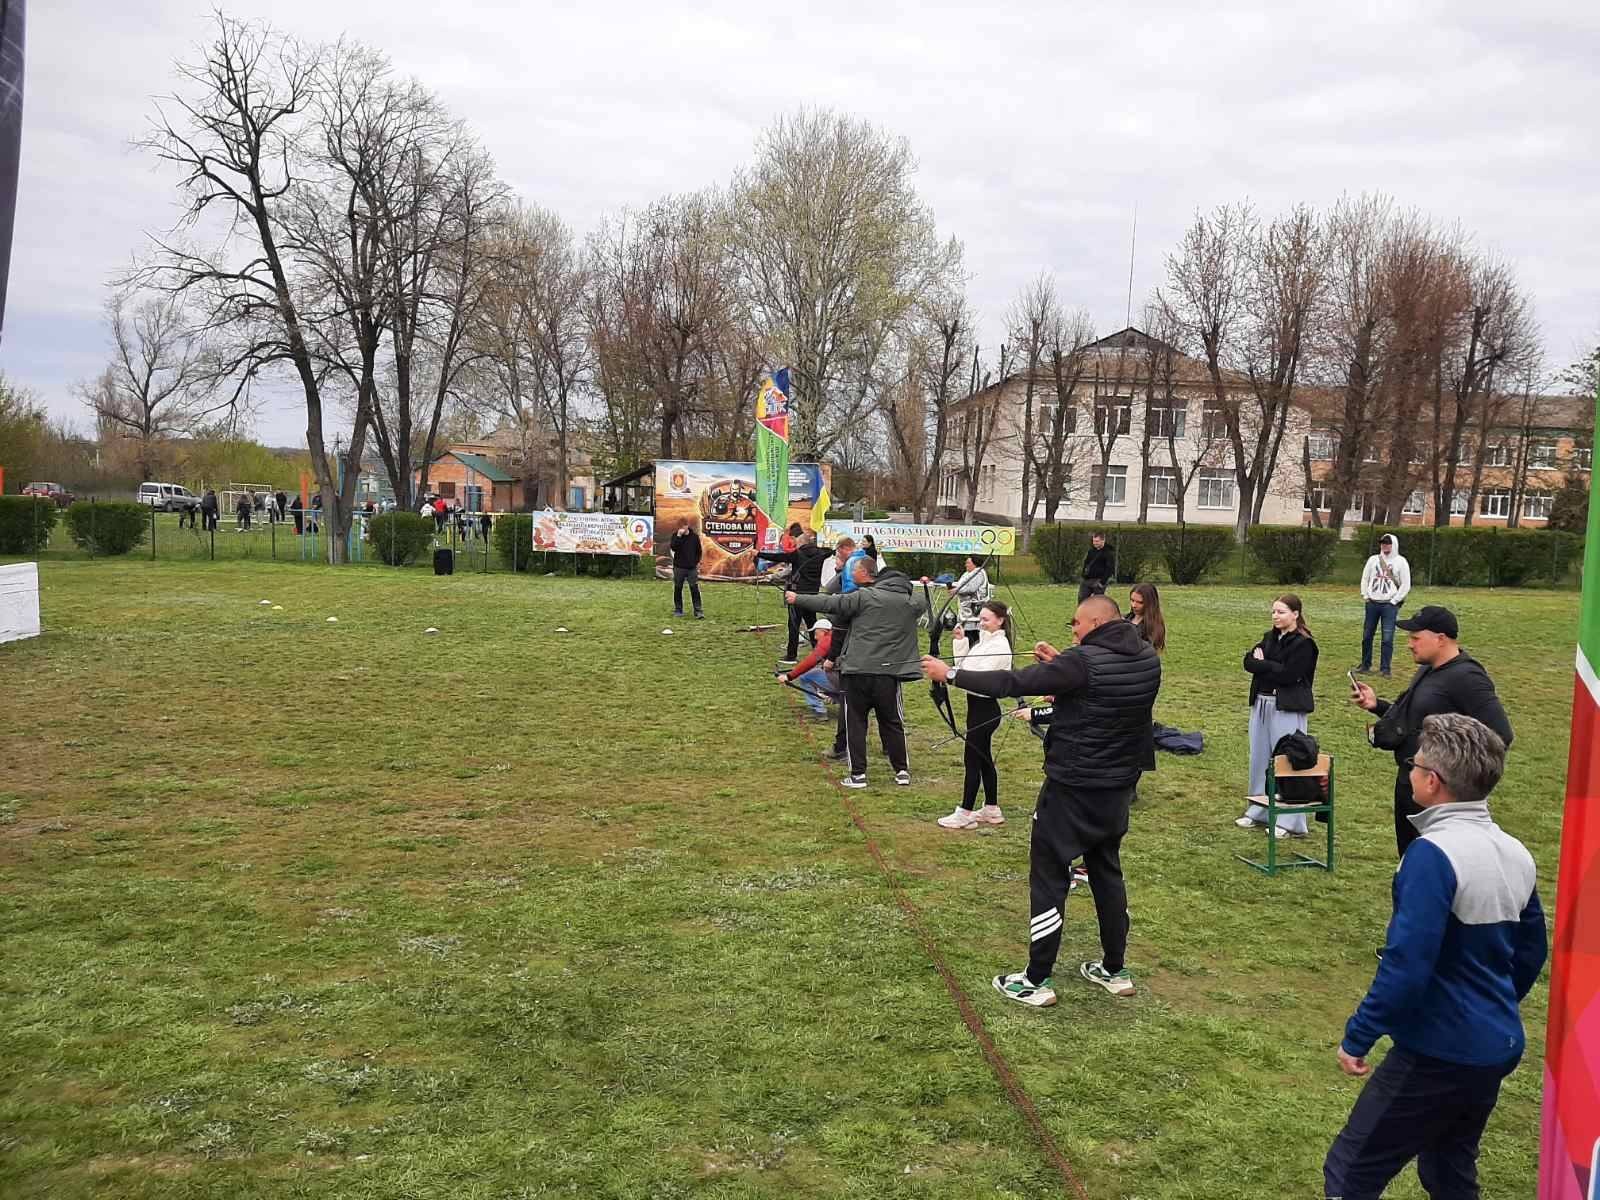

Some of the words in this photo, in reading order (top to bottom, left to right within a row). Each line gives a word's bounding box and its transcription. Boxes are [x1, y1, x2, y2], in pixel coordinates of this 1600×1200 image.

[705, 521, 742, 531] СТЕПОВА
[853, 526, 905, 536] ВІТАЄМО
[906, 527, 977, 538] УЧАСНИКІВ
